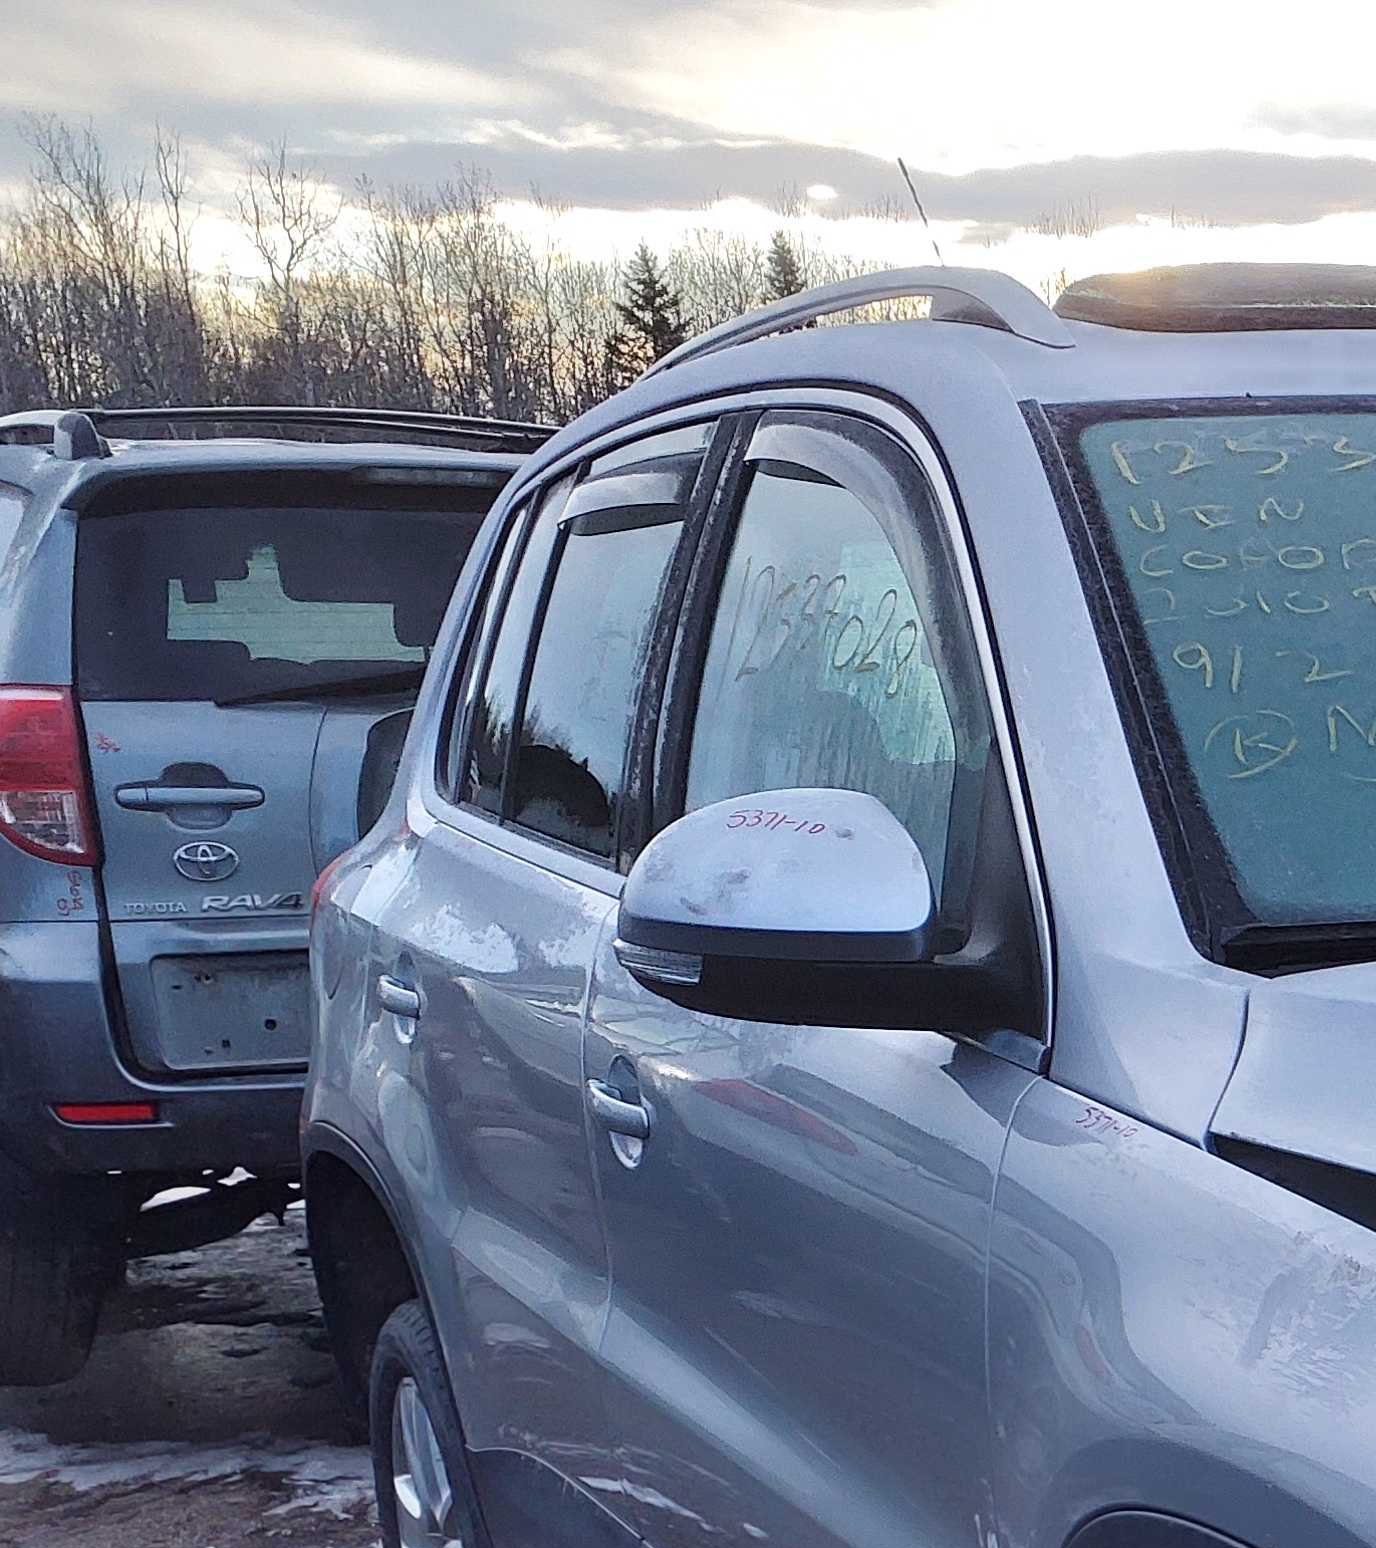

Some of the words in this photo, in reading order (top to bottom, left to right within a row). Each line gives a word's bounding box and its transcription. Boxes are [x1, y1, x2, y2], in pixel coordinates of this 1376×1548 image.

[726, 809, 826, 834] 5371-10
[123, 902, 188, 915] TOYOTA
[201, 891, 304, 915] RAV4
